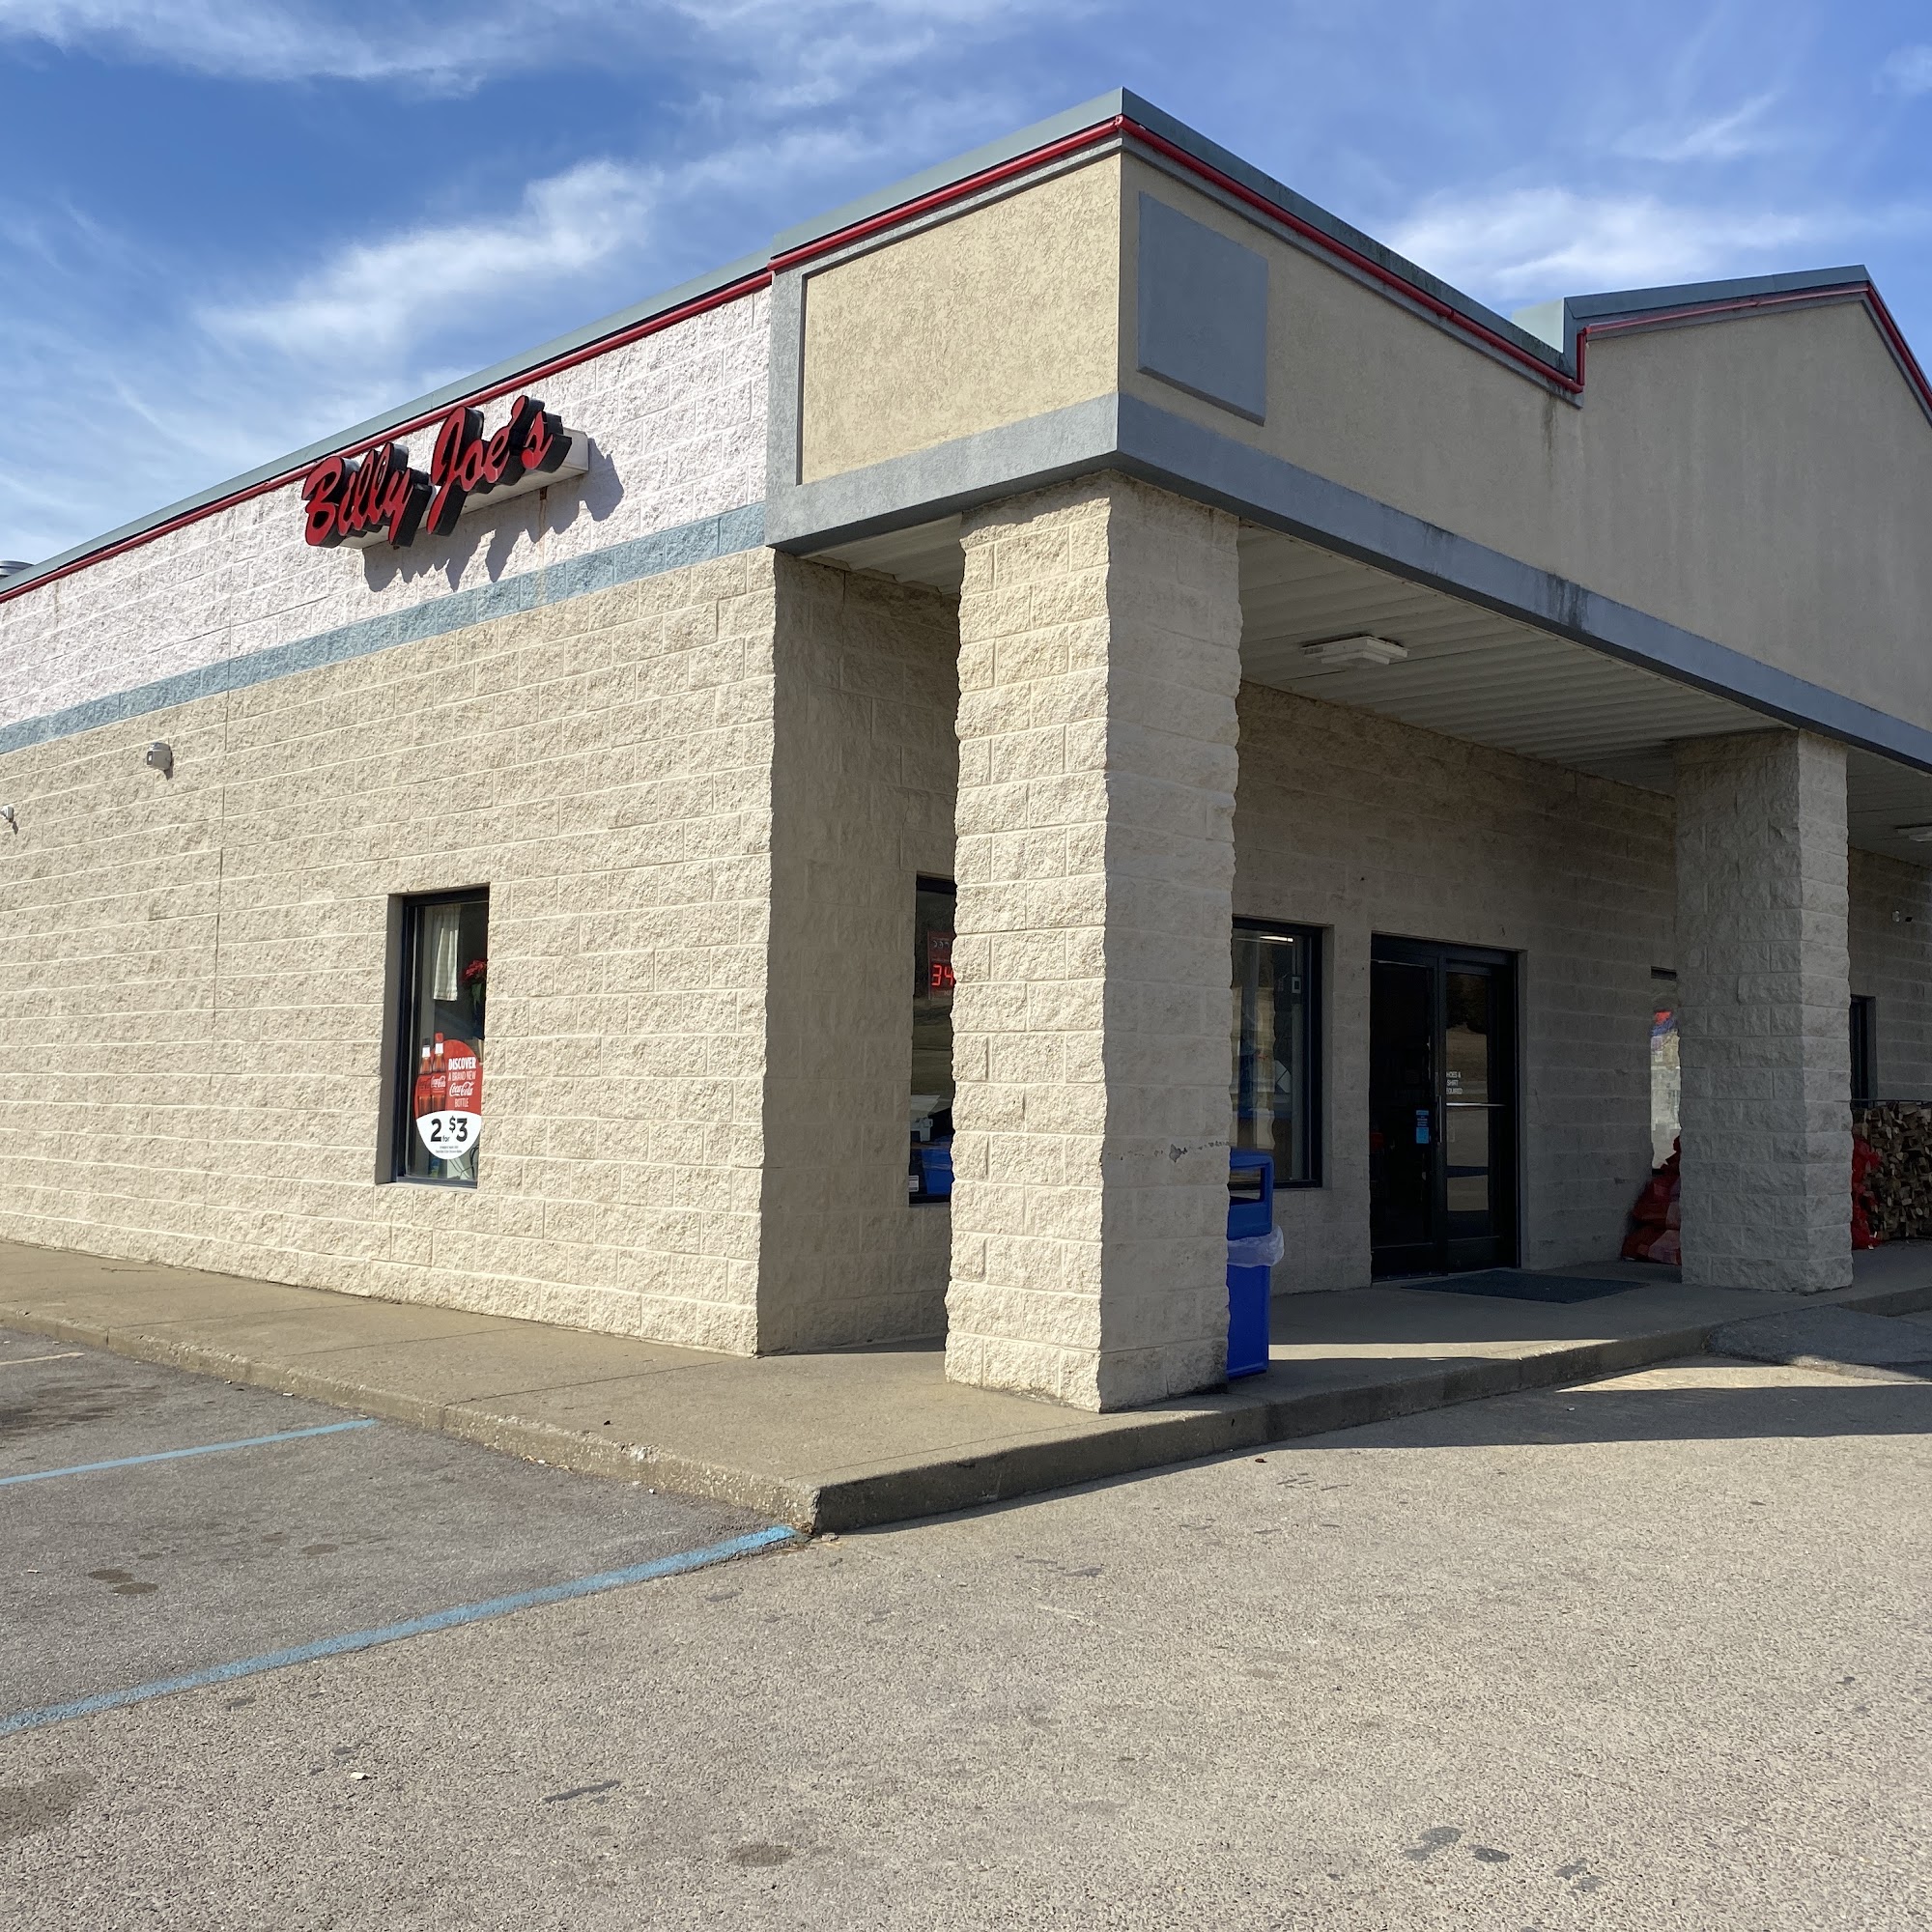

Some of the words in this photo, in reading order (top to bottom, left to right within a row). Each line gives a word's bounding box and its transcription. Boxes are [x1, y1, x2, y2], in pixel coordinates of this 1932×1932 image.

[301, 442, 415, 547] Billy
[427, 394, 560, 535] Joe's
[448, 1057, 476, 1070] DISCOVER
[448, 1071, 452, 1081] A
[452, 1071, 466, 1081] BRAND
[467, 1070, 476, 1080] NEW
[455, 1098, 469, 1107] BOTTLE
[431, 1119, 441, 1142] 2
